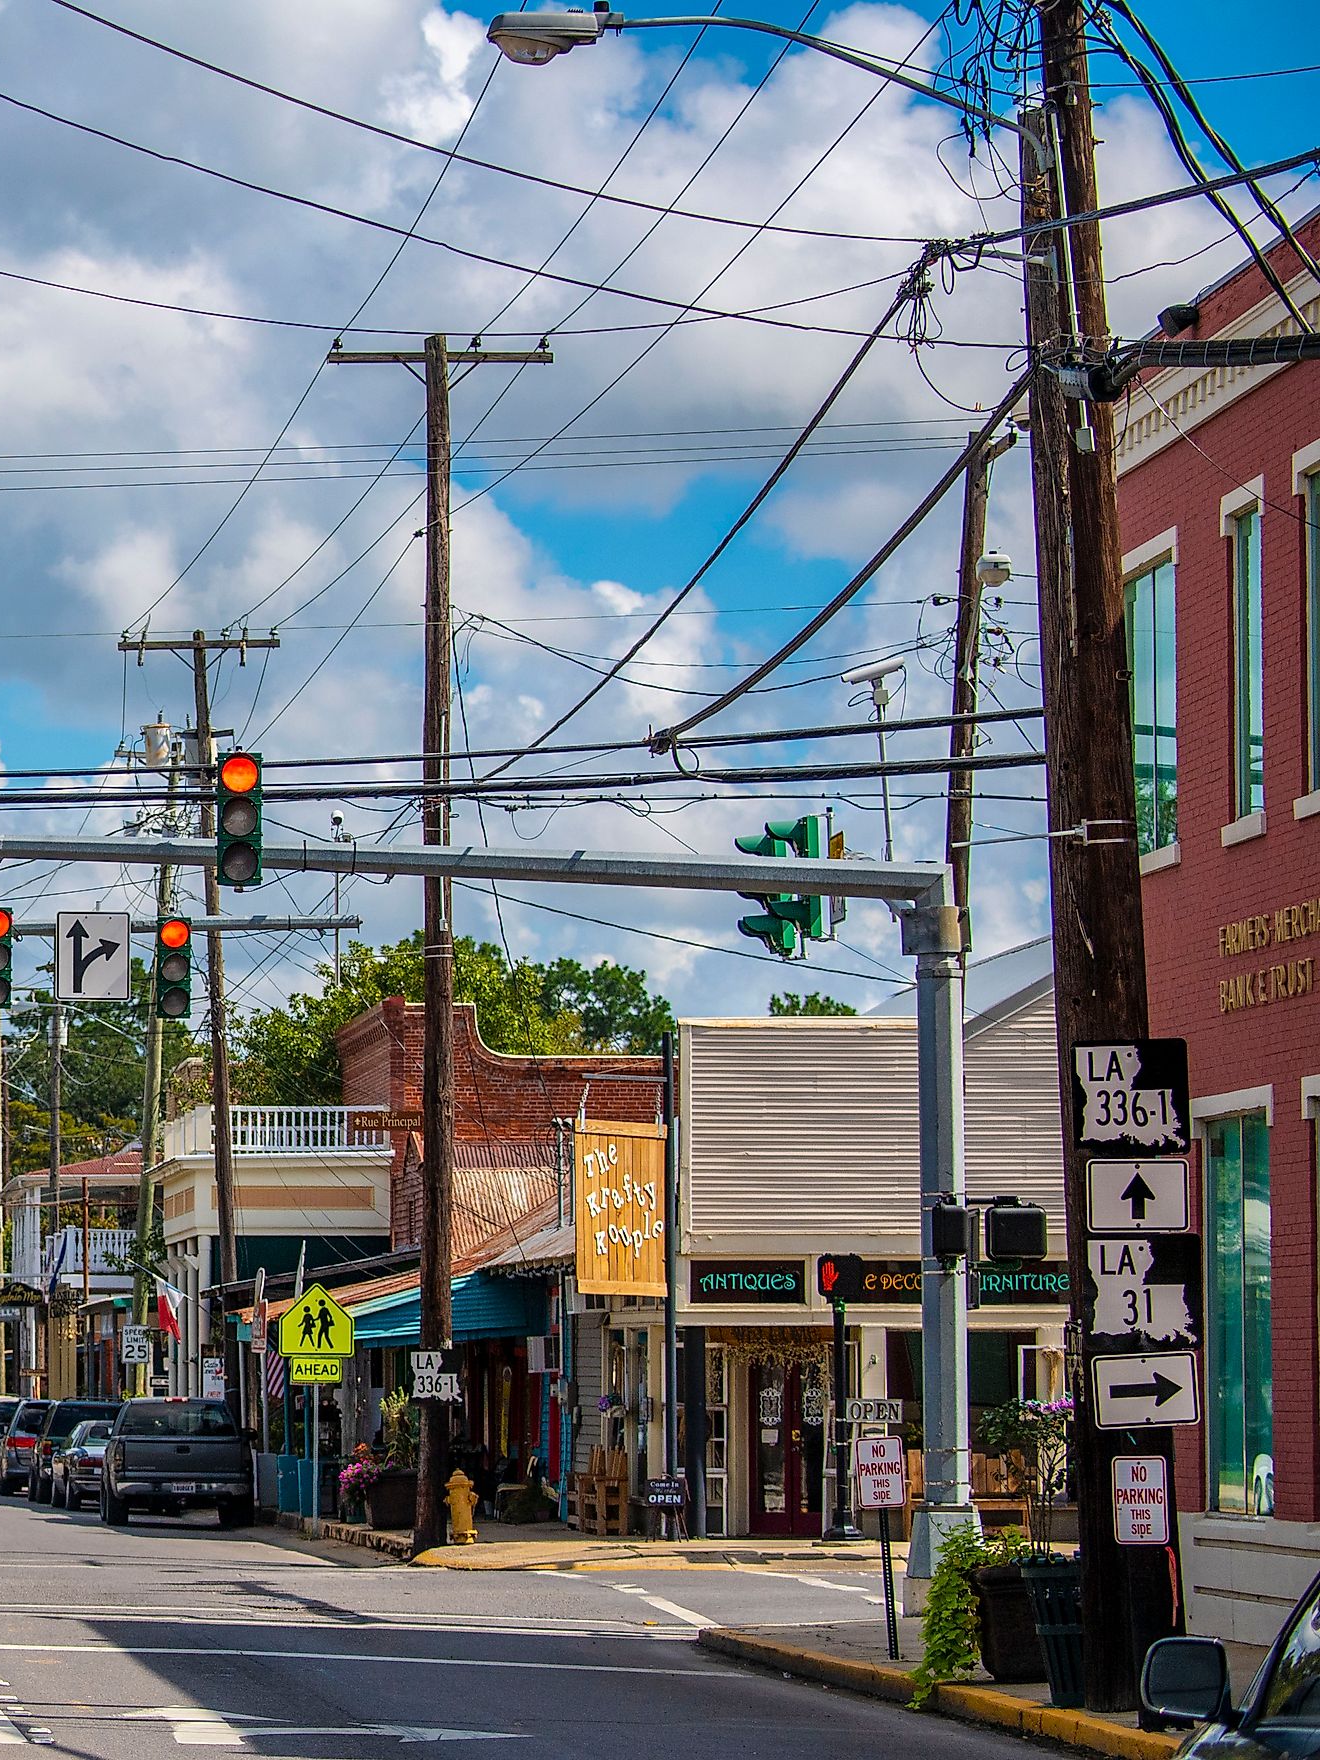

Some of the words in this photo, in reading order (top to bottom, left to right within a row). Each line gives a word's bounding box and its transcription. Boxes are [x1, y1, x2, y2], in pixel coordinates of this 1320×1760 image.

[1220, 973, 1256, 1013] BANK
[1258, 970, 1268, 1002] &
[1269, 957, 1314, 1000] TRUST
[1087, 1051, 1125, 1082] LA
[1095, 1089, 1168, 1127] 336-1
[361, 1116, 379, 1127] Rue
[382, 1115, 421, 1130] Principal
[583, 1143, 618, 1178] The
[585, 1173, 657, 1218] Krafty
[594, 1211, 664, 1258] Kouple
[1099, 1244, 1136, 1275] LA
[700, 1272, 796, 1292] ANTIQUES
[979, 1272, 1070, 1293] URNITURE
[1122, 1288, 1153, 1326] 31
[124, 1328, 147, 1336] SPEE
[124, 1344, 147, 1359] 25
[294, 1363, 339, 1376] AHEAD
[416, 1353, 435, 1369] LA
[417, 1375, 454, 1393] 336-1
[850, 1401, 900, 1420] OPEN
[871, 1444, 886, 1458] NO
[860, 1461, 901, 1476] PARKING
[1131, 1465, 1147, 1482] NO
[871, 1479, 890, 1488] THIS
[648, 1494, 682, 1504] OPEN
[872, 1490, 891, 1500] SIDE
[1116, 1488, 1164, 1505] PARKING
[1129, 1508, 1151, 1520] THIS
[1131, 1523, 1153, 1535] SIDE
